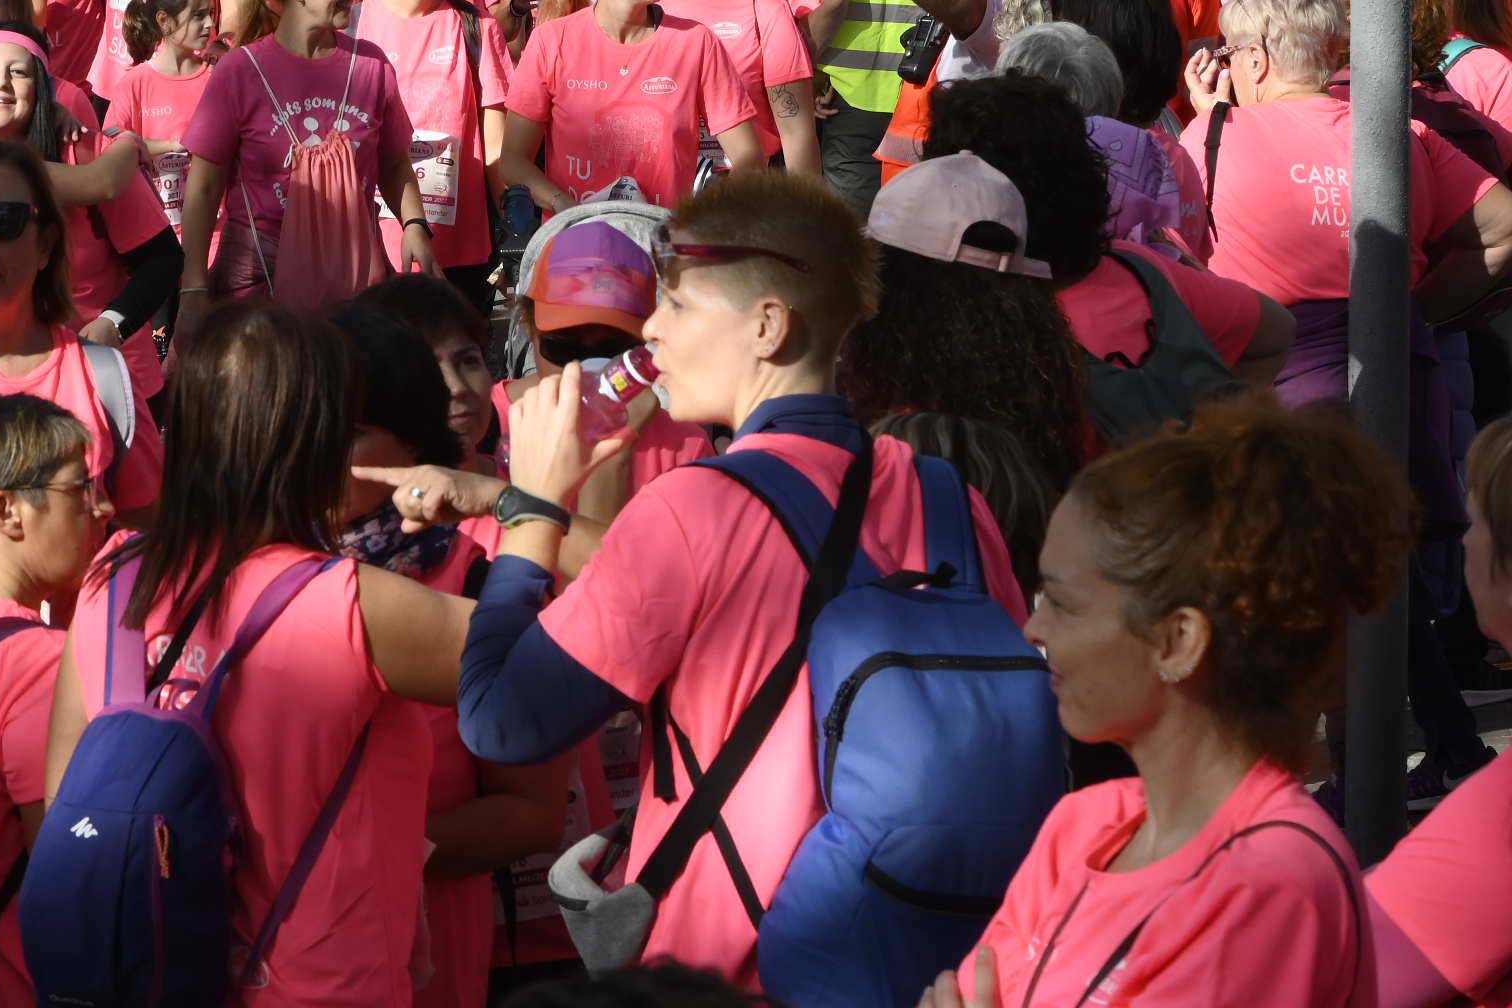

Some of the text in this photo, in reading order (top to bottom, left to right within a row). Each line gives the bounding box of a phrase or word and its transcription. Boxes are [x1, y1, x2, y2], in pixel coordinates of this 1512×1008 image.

[567, 79, 608, 90] OYSHO
[567, 155, 592, 180] TU
[1291, 164, 1350, 186] CARR
[1314, 186, 1341, 206] DE
